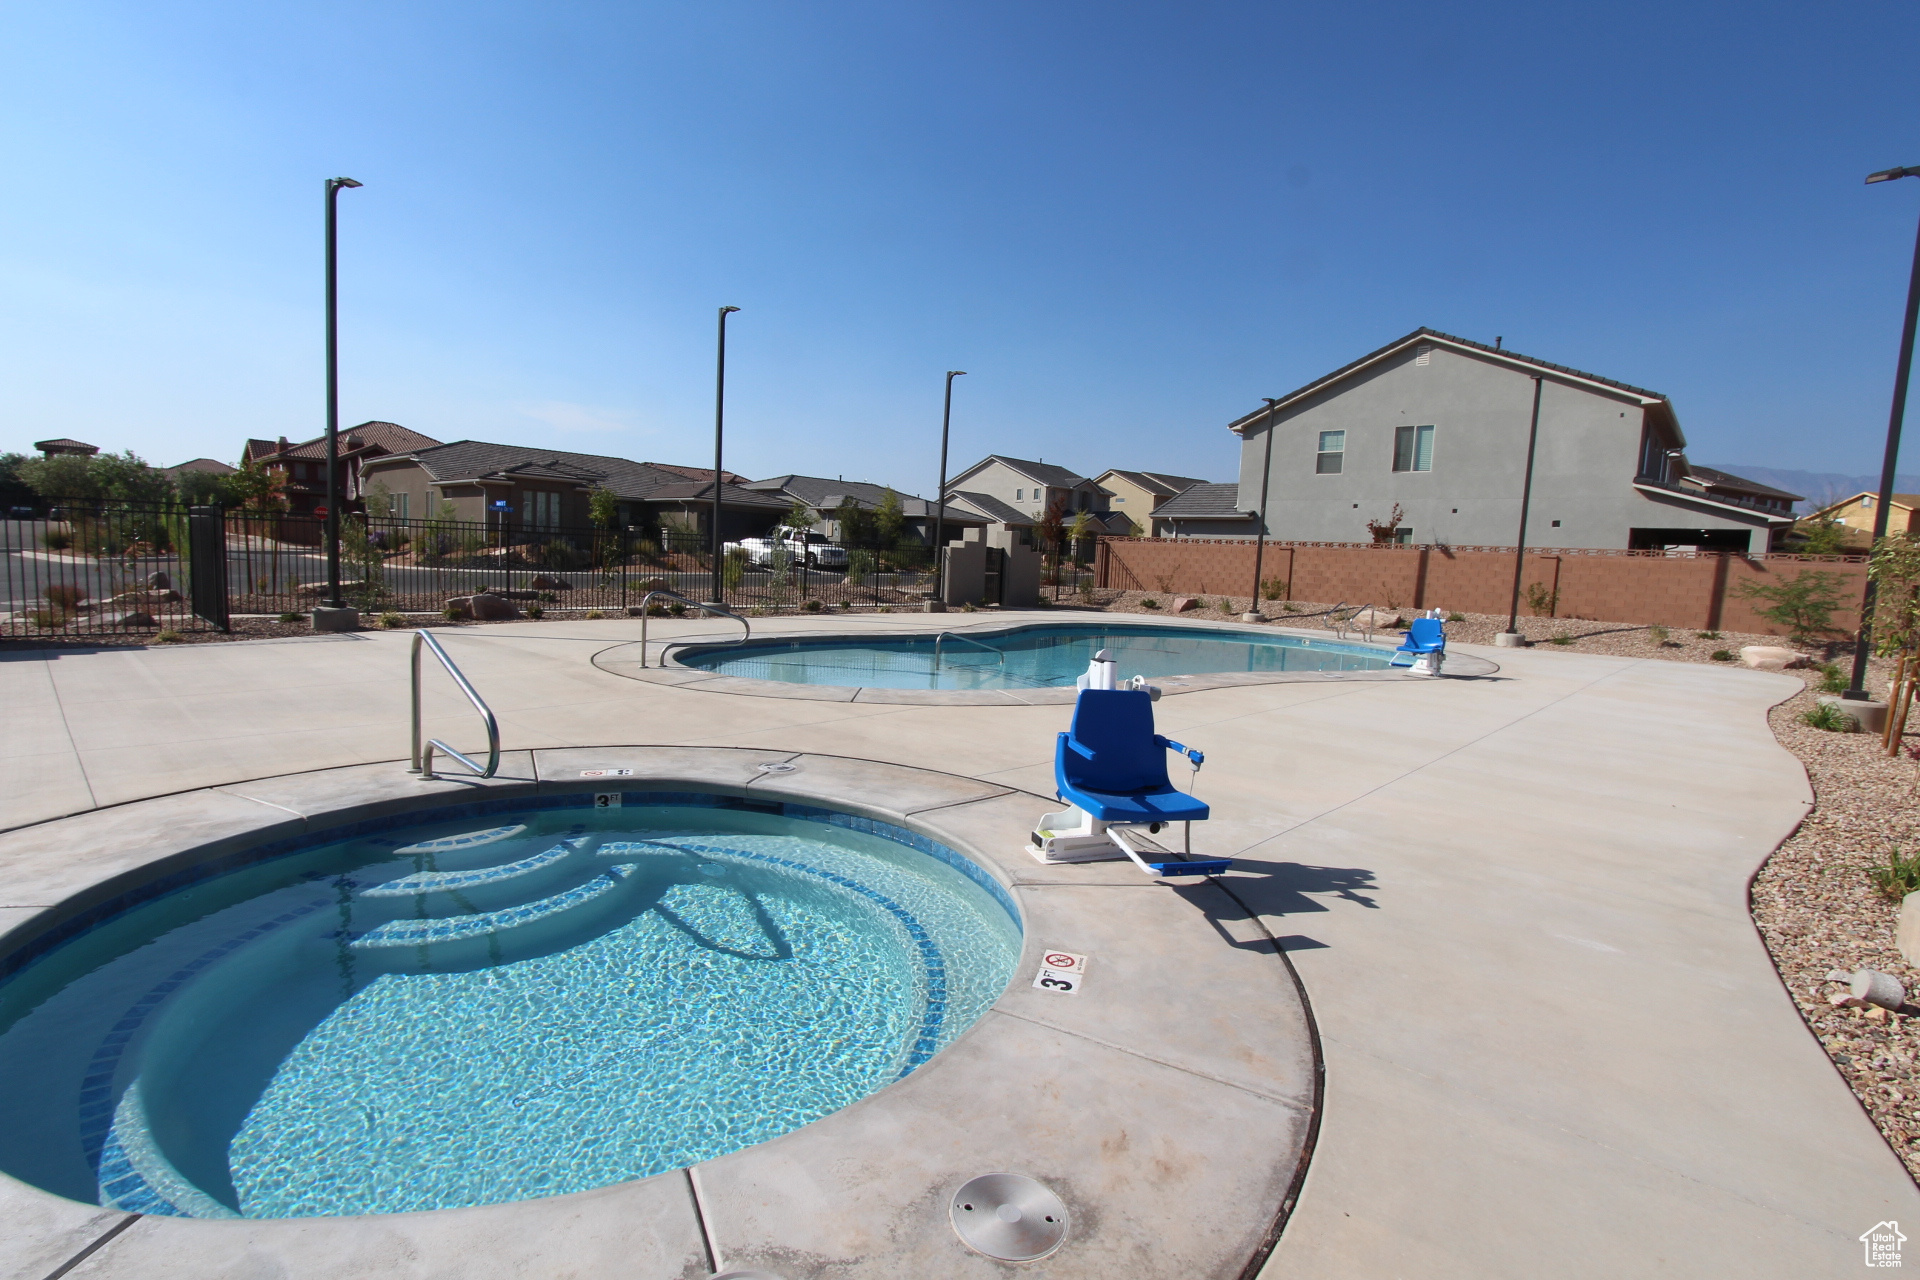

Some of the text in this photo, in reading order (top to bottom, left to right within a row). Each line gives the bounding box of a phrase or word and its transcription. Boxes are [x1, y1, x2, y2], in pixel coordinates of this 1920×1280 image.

[597, 794, 609, 807] 3
[1040, 969, 1073, 991] 3 FT
